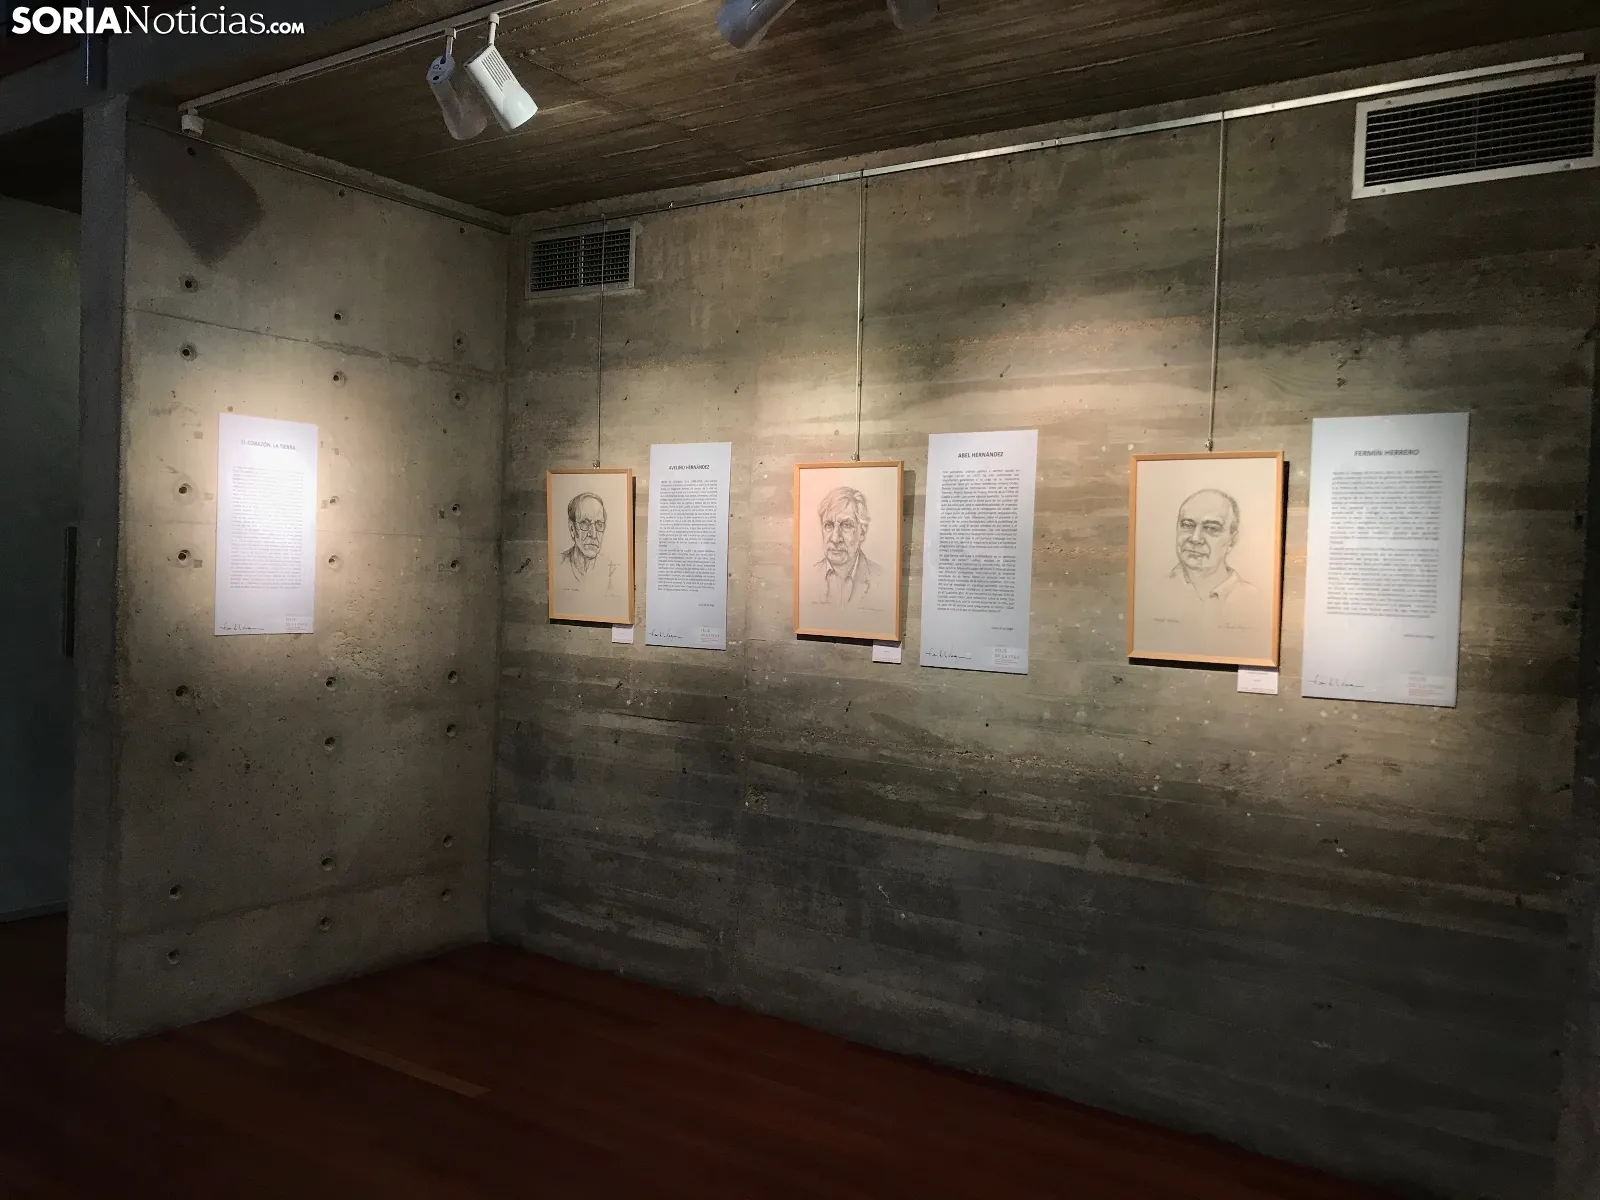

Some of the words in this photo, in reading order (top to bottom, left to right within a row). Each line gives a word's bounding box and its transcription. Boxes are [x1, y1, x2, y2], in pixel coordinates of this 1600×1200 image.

[971, 450, 1004, 458] HERNÁNDEZ
[1354, 449, 1382, 457] FERMÍN
[1383, 449, 1420, 457] HERRERO
